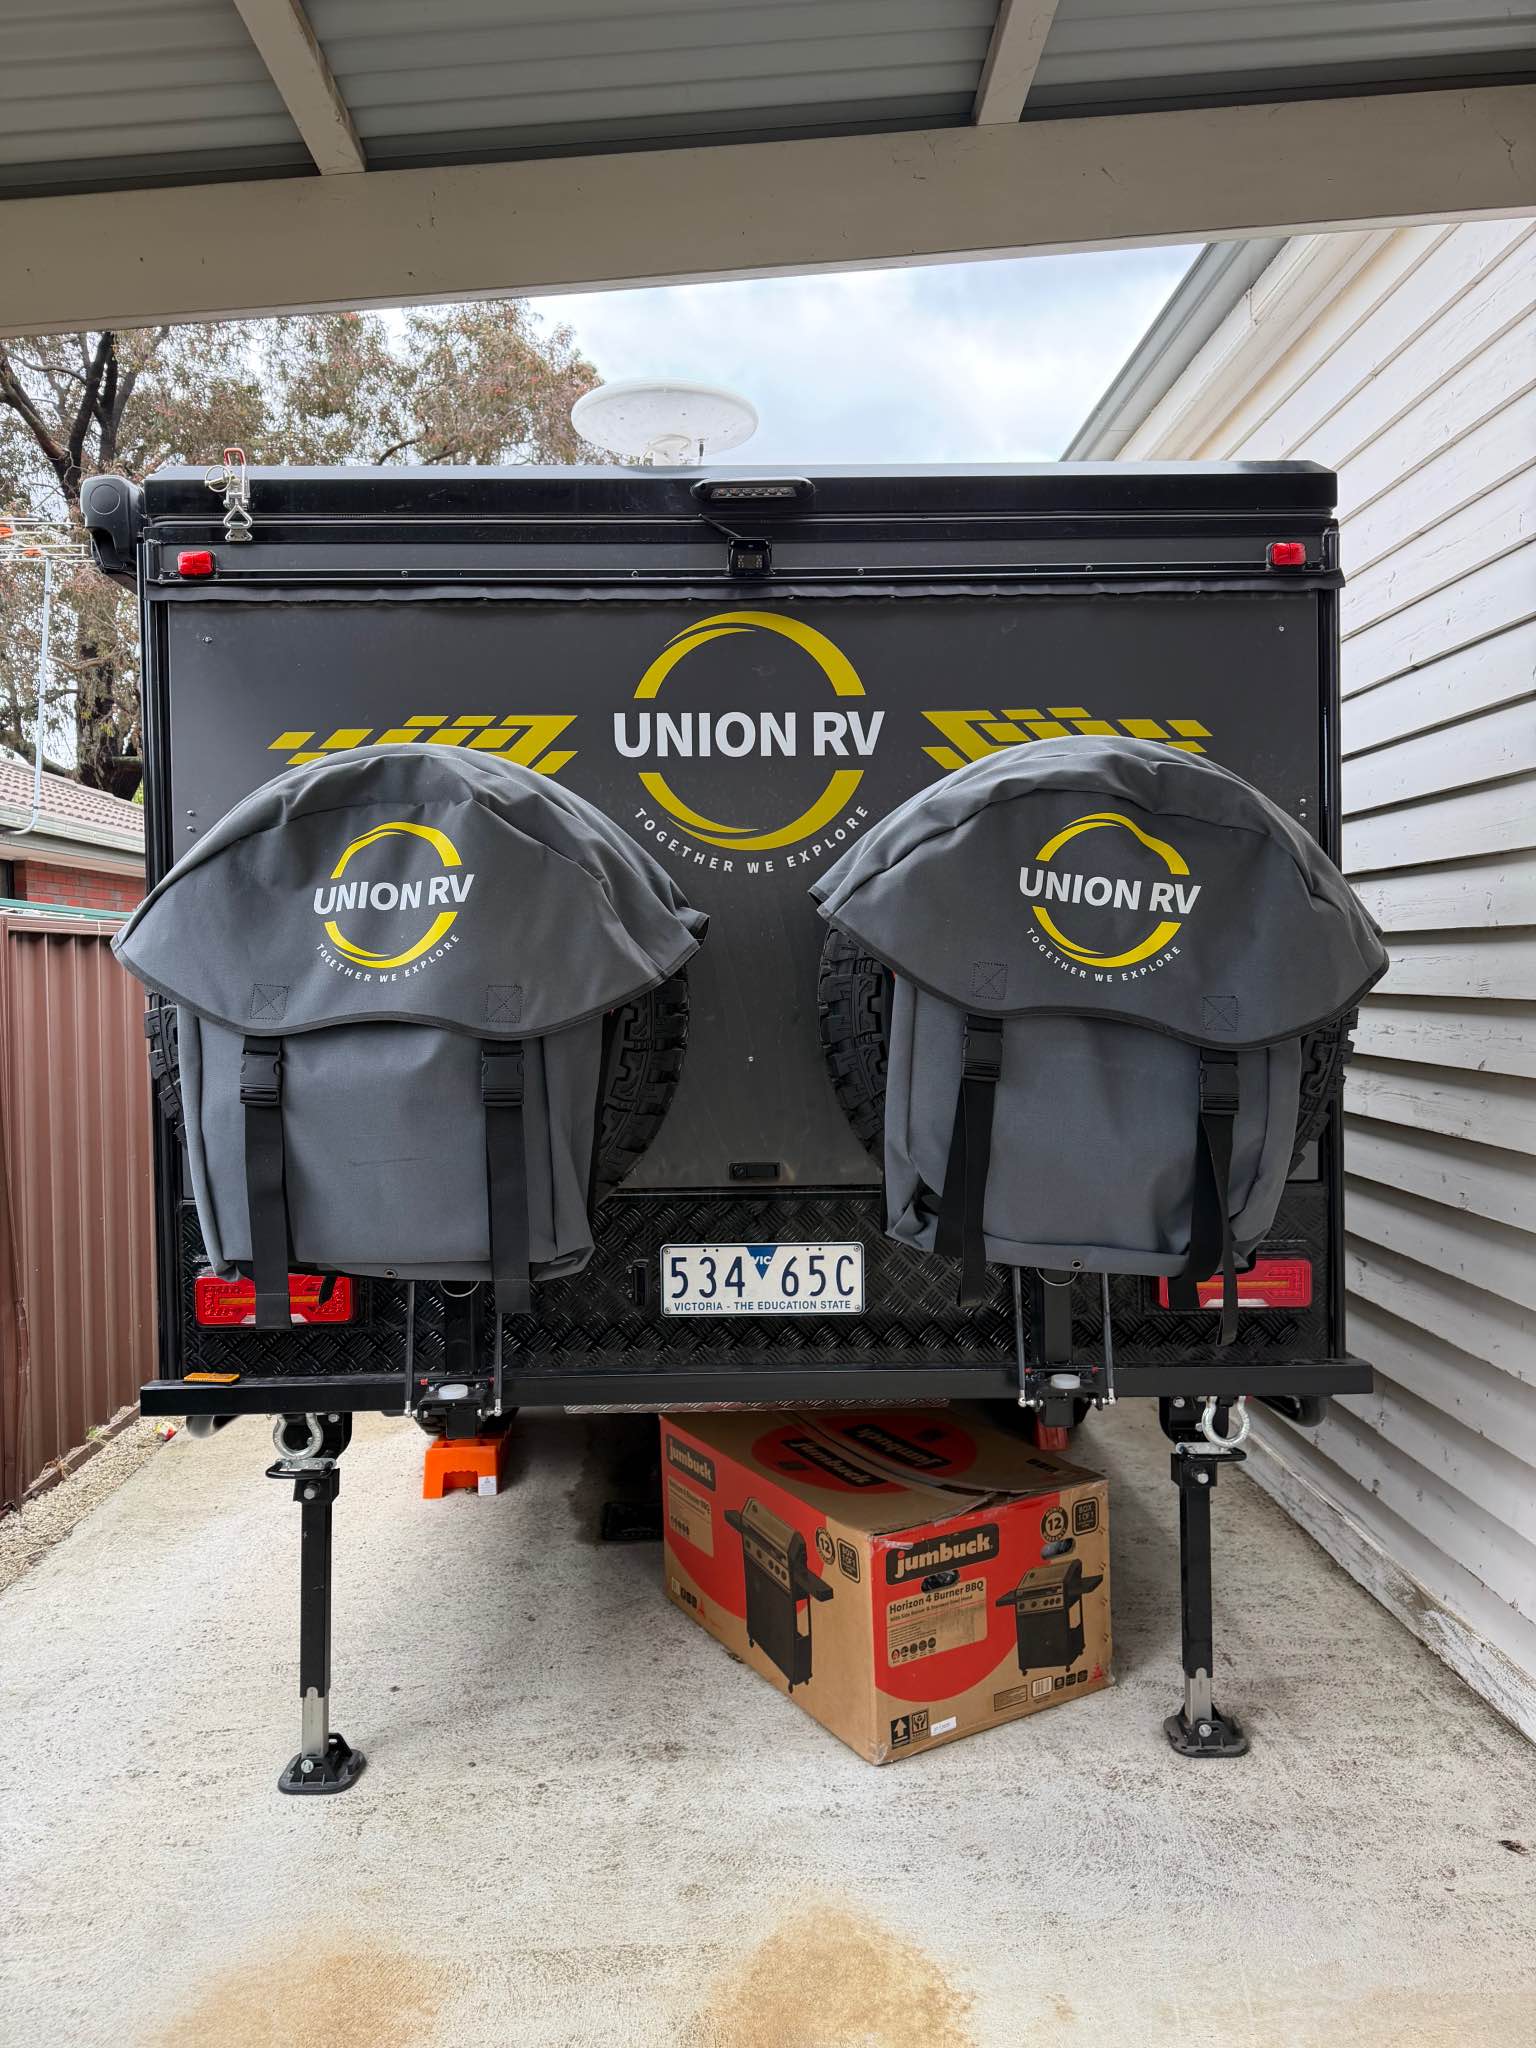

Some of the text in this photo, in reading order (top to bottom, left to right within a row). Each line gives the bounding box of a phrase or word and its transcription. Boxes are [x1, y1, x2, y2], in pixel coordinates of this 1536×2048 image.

[613, 710, 886, 758] UNION RV
[634, 805, 869, 874] TOGETHER WE EXPLORE
[313, 874, 475, 915] UNION RV
[1019, 866, 1202, 915] UNION RV
[315, 934, 460, 983] TOGETHER WE EXPLORE
[1026, 927, 1182, 982] TOGETHER WE EXPLORE
[671, 1255, 854, 1299] 534 65C
[750, 1255, 771, 1265] VIC
[674, 1302, 723, 1311] VICTORIA
[734, 1301, 754, 1310] THE
[757, 1300, 817, 1310] EDUCATION
[820, 1300, 851, 1309] STATE
[820, 1538, 831, 1554] 12
[1047, 1517, 1062, 1532] 12
[894, 1533, 990, 1579] jumbuck
[889, 1597, 924, 1614] Horizon
[925, 1594, 932, 1603] 4
[933, 1587, 964, 1601] Burner
[965, 1581, 984, 1592] BBQ
